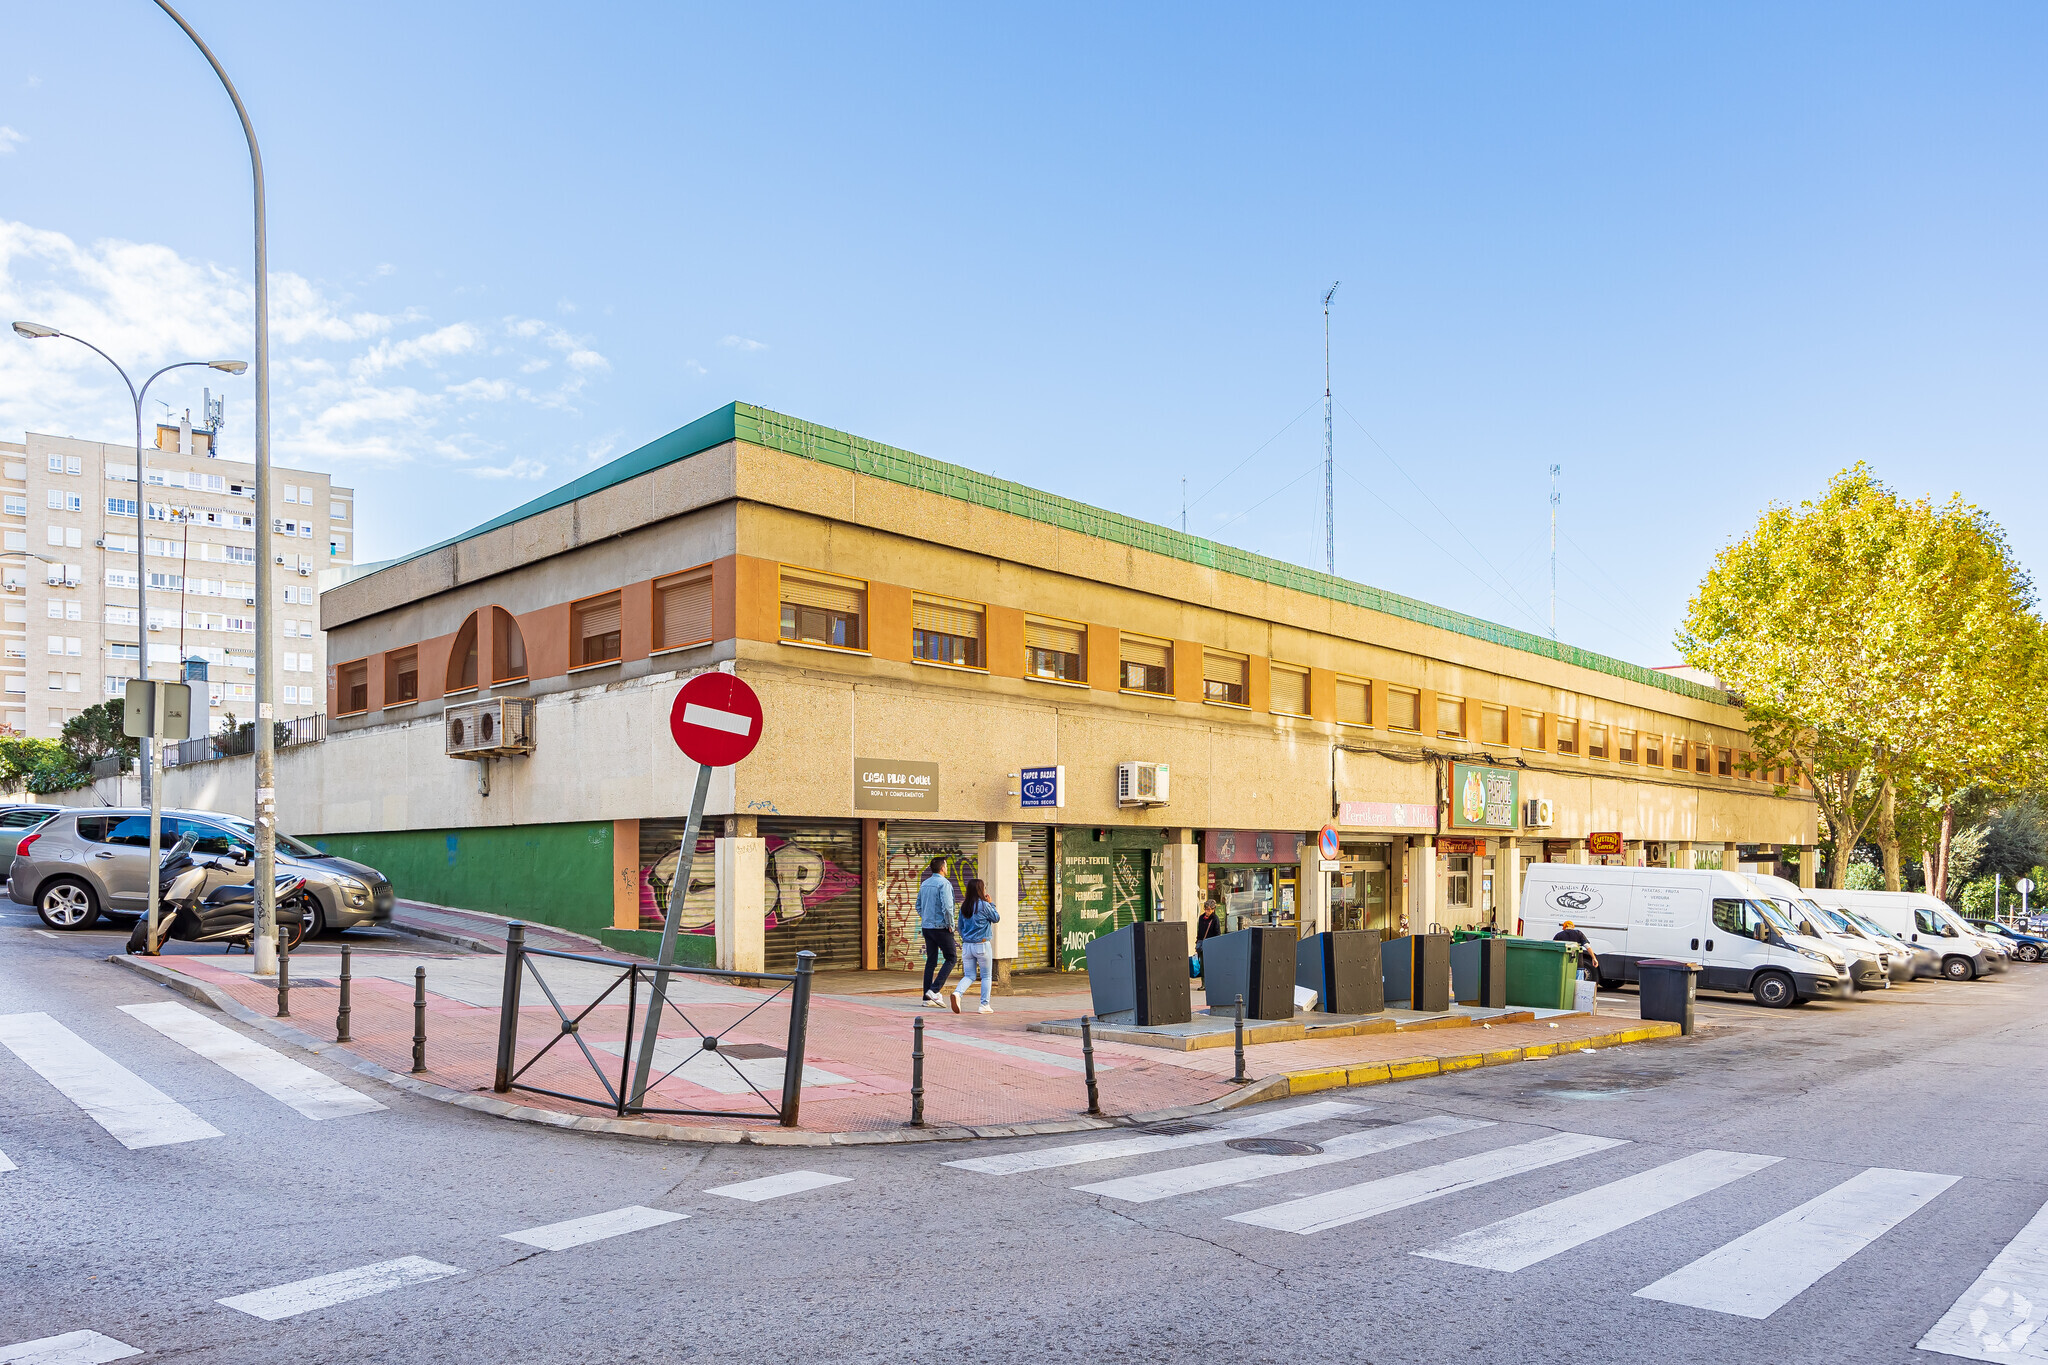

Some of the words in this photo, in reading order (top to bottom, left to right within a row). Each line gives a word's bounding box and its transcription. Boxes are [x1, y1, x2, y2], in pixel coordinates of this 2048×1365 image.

[862, 772, 885, 784] CASA
[1022, 771, 1038, 780] SUPER
[1029, 784, 1049, 794] 0.60€
[1486, 778, 1512, 805] PARQUE
[889, 791, 925, 799] COMPLEMENTOS
[1412, 807, 1434, 825] Nuka
[1485, 803, 1511, 826] GRANADA
[1065, 856, 1111, 865] HIPER-TEXTIL
